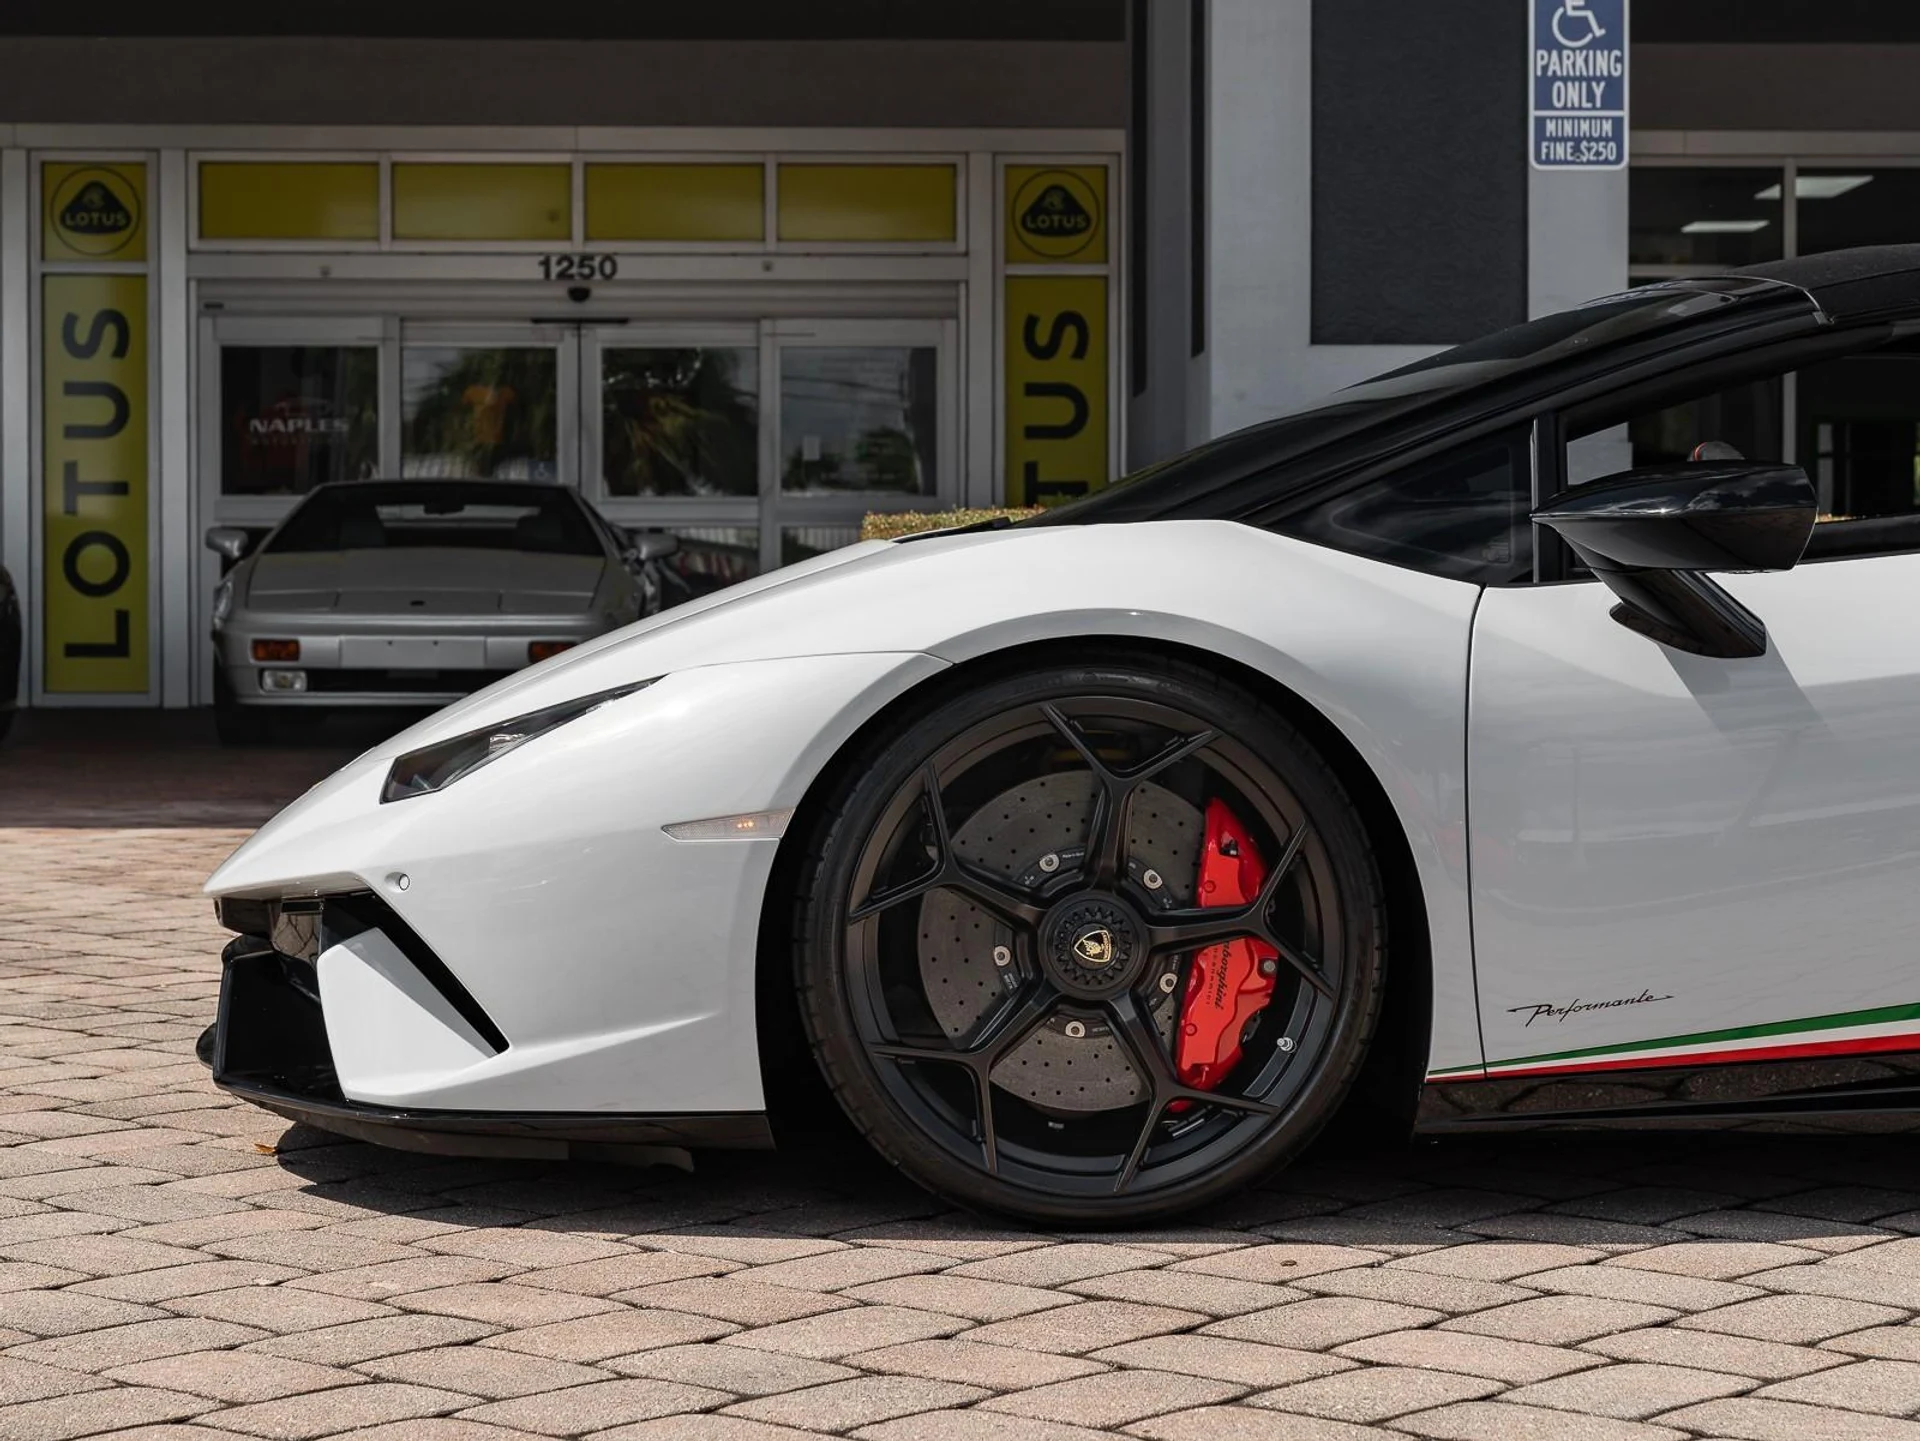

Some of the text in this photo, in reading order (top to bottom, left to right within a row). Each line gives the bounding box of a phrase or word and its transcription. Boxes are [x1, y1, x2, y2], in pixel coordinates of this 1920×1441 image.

[1536, 49, 1622, 77] PARKING
[1552, 81, 1606, 109] ONLY
[1546, 118, 1613, 138] MINIMUM
[1541, 140, 1617, 163] FINE $250
[64, 211, 127, 227] LOTUS
[1026, 214, 1087, 229] LOTUS
[537, 253, 618, 281] 1250
[1022, 309, 1090, 508] TUS
[249, 418, 350, 433] NAPLES
[62, 308, 131, 659] LOTUS
[1506, 989, 1675, 1028] Performante
